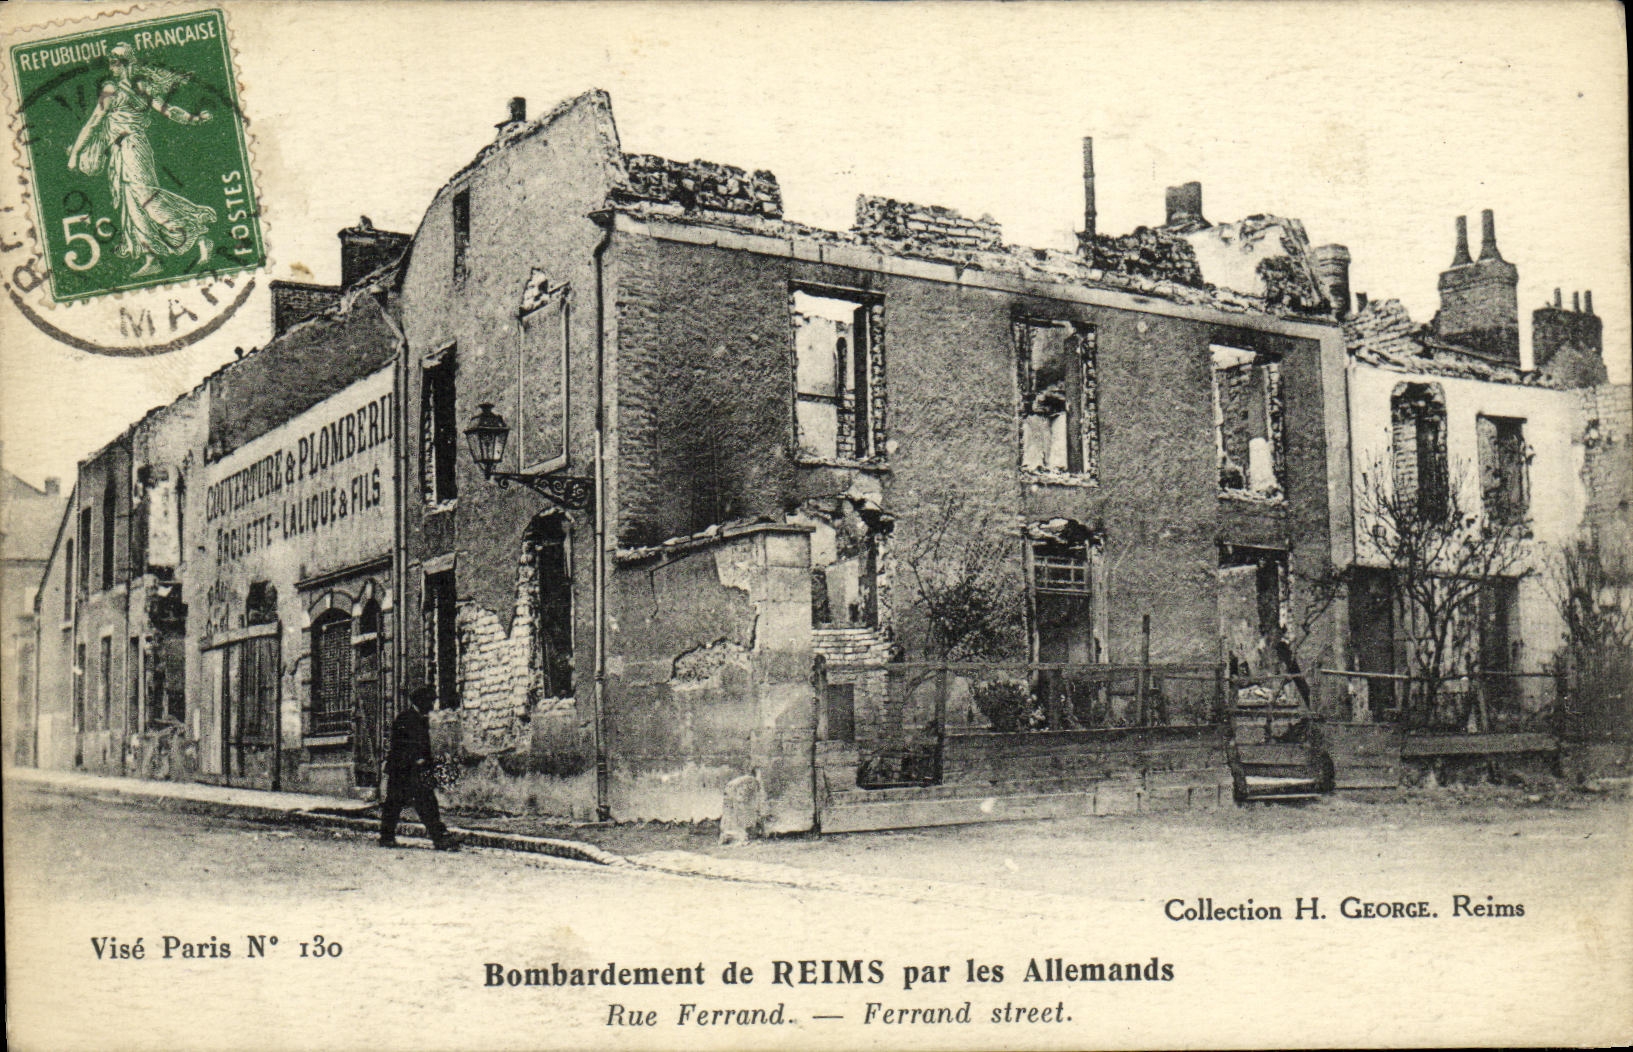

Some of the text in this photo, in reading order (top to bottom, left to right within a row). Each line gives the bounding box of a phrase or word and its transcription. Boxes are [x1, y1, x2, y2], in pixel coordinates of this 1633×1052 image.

[134, 21, 216, 51] FRANÇAISE
[206, 449, 283, 523] COUVERTURE
[285, 452, 296, 486] &
[339, 488, 348, 519] &
[351, 467, 381, 515] FILS
